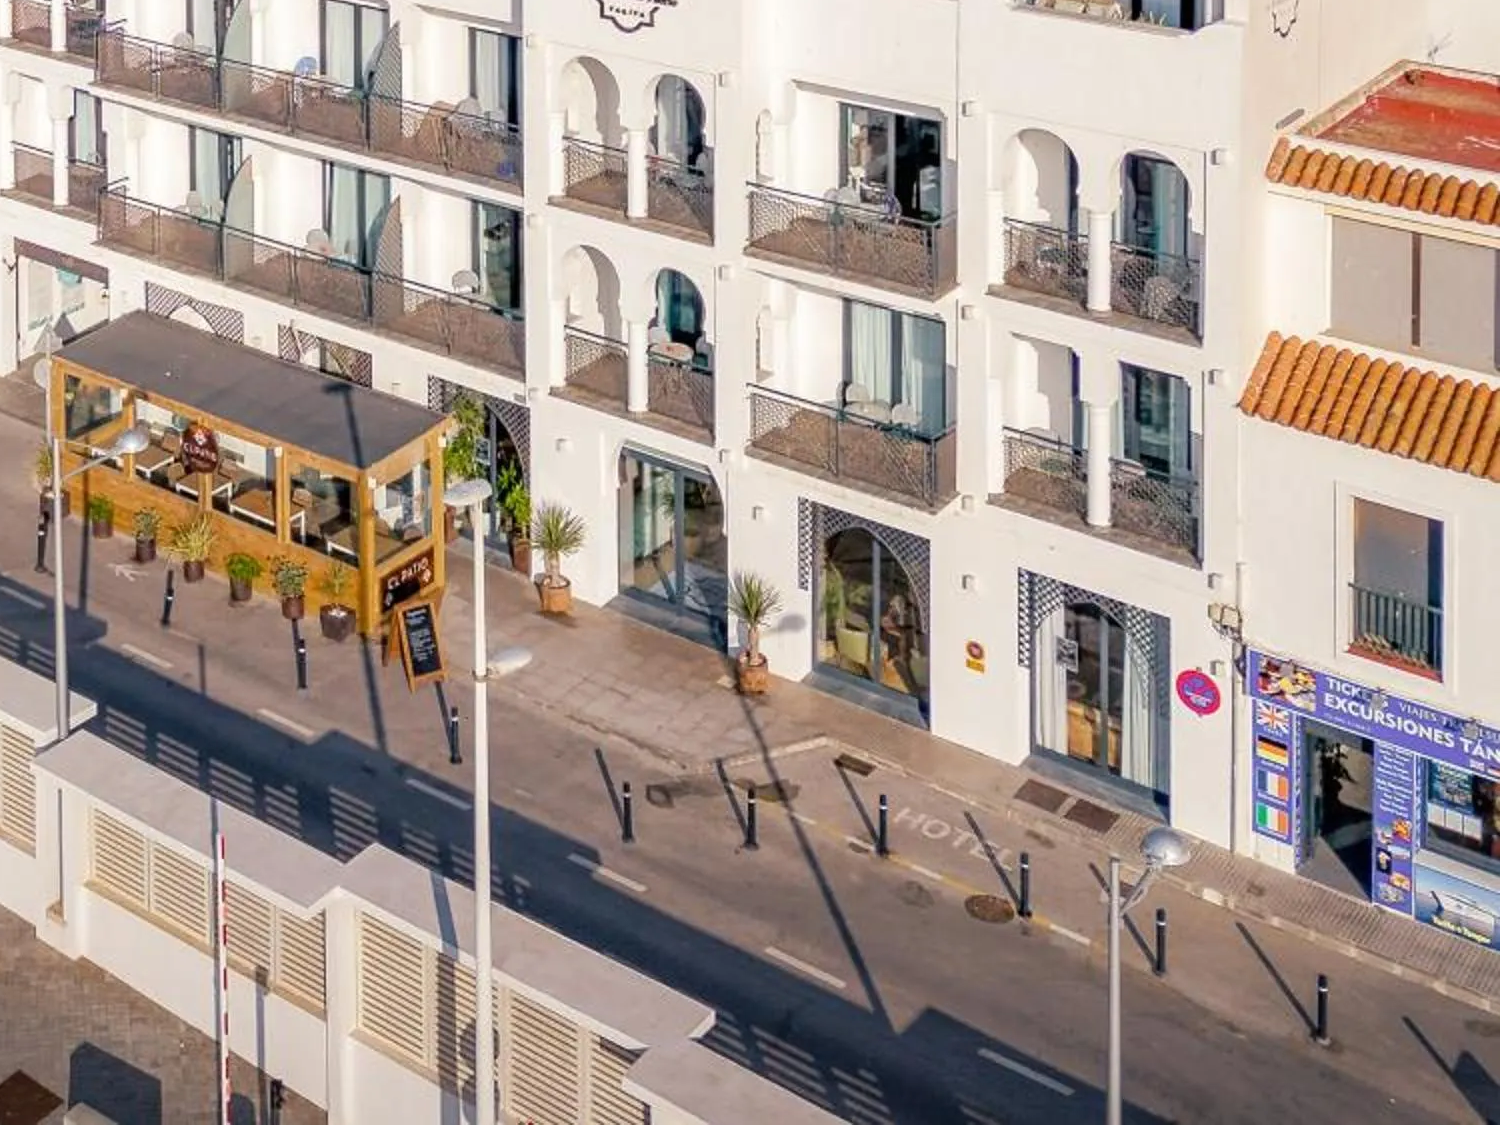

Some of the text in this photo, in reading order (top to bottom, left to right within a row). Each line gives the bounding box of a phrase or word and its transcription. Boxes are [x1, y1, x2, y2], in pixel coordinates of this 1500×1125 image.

[1324, 693, 1455, 749] EXCURSIONES
[1399, 702, 1437, 722] VIAJES
[894, 807, 1012, 872] HOTEL
